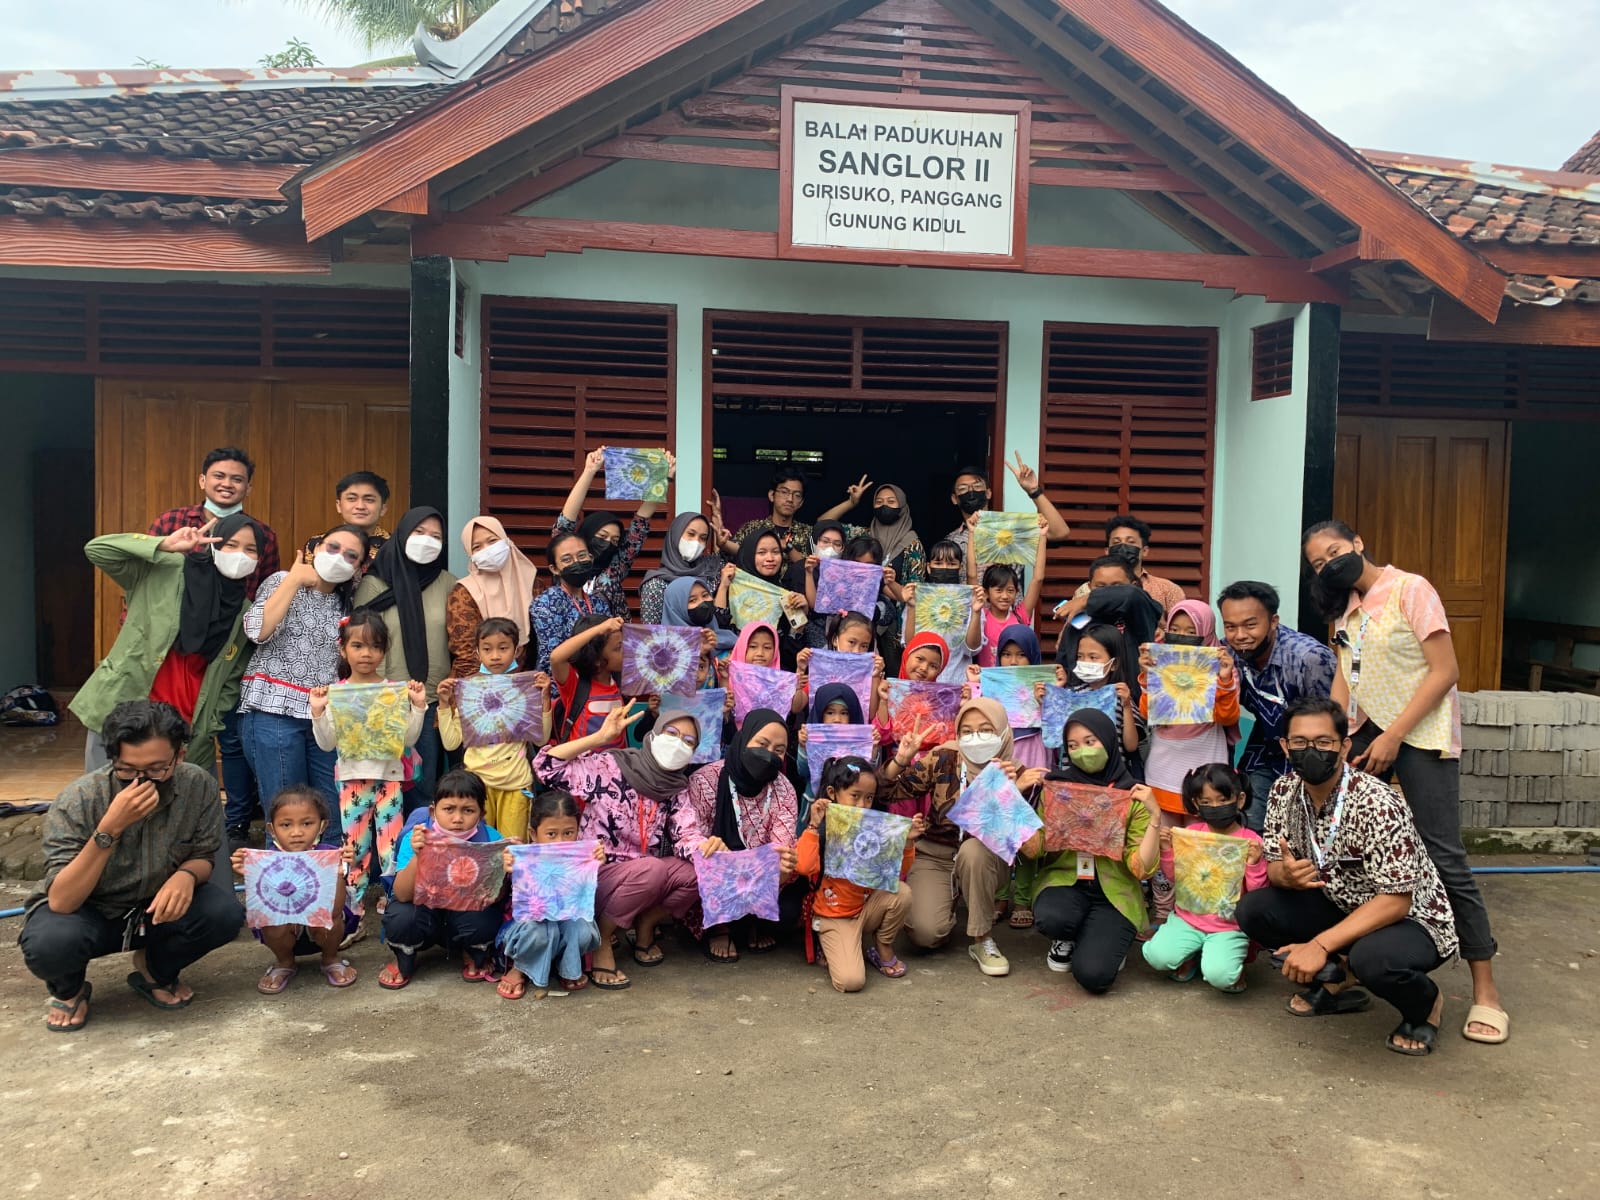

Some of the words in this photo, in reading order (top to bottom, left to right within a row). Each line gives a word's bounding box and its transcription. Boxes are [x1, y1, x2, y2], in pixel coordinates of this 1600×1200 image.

[805, 120, 867, 141] BALAI
[874, 125, 1003, 149] PADUKUHAN
[818, 149, 966, 181] SANGLOR
[975, 158, 990, 182] II
[802, 183, 895, 206] GIRISUKO,
[901, 189, 1003, 209] PANGGANG
[829, 212, 907, 231] GUNUNG
[912, 217, 966, 234] KIDUL
